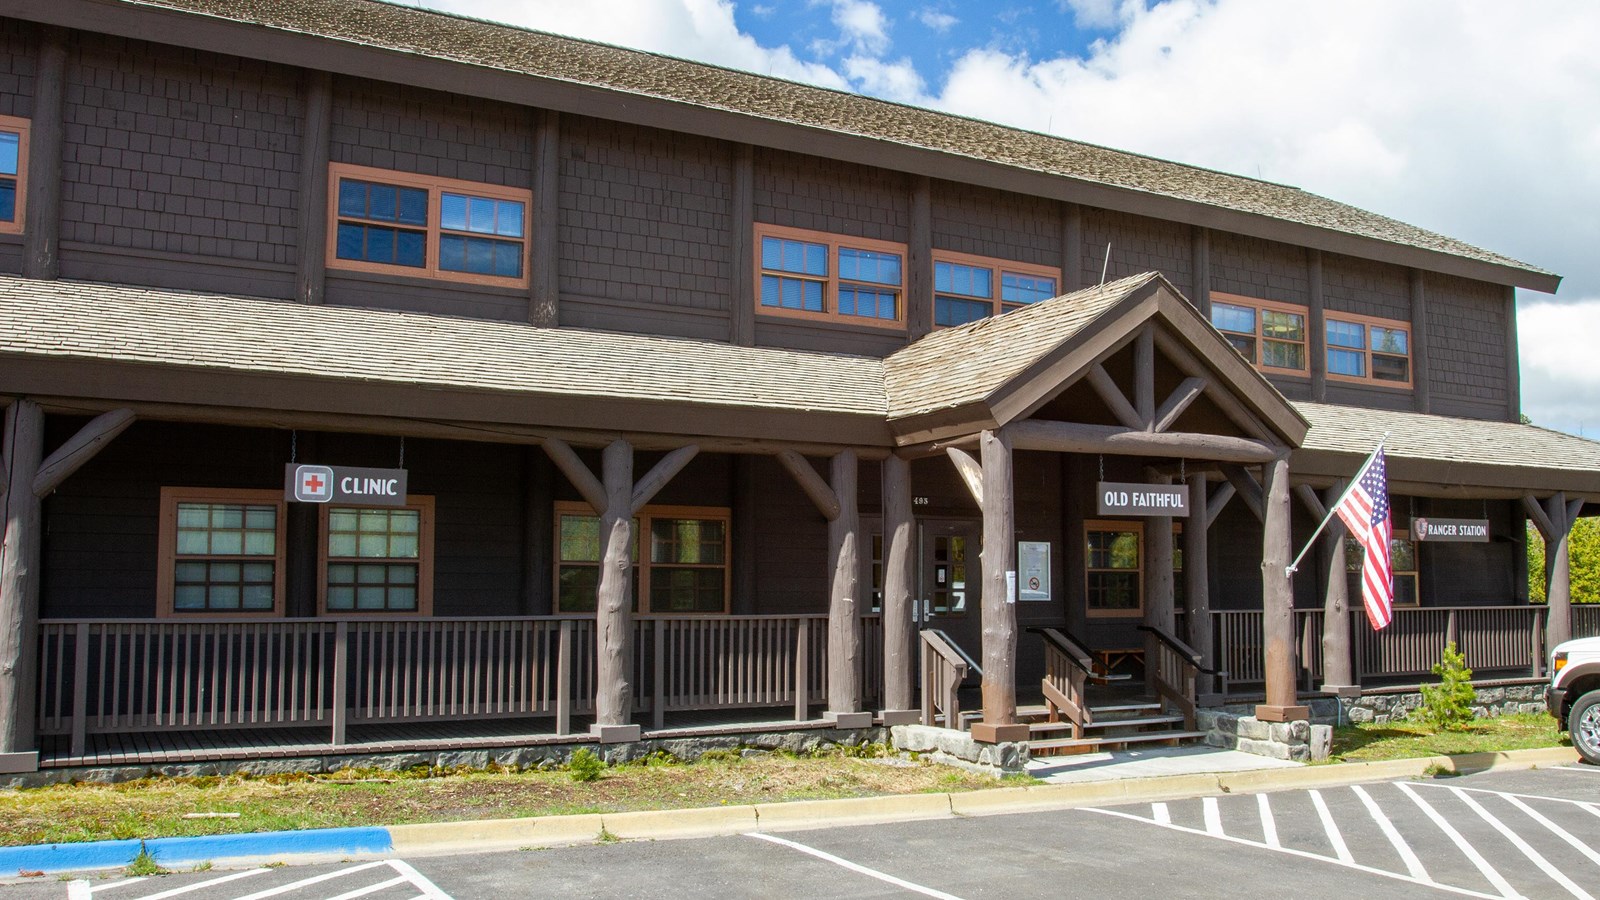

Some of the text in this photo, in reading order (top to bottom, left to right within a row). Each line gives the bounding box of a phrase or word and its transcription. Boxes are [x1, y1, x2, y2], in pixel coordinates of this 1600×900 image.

[341, 477, 398, 496] CLINIC
[1104, 491, 1183, 507] OLD FAITHFUL
[1428, 524, 1486, 536] RANGER STATION
